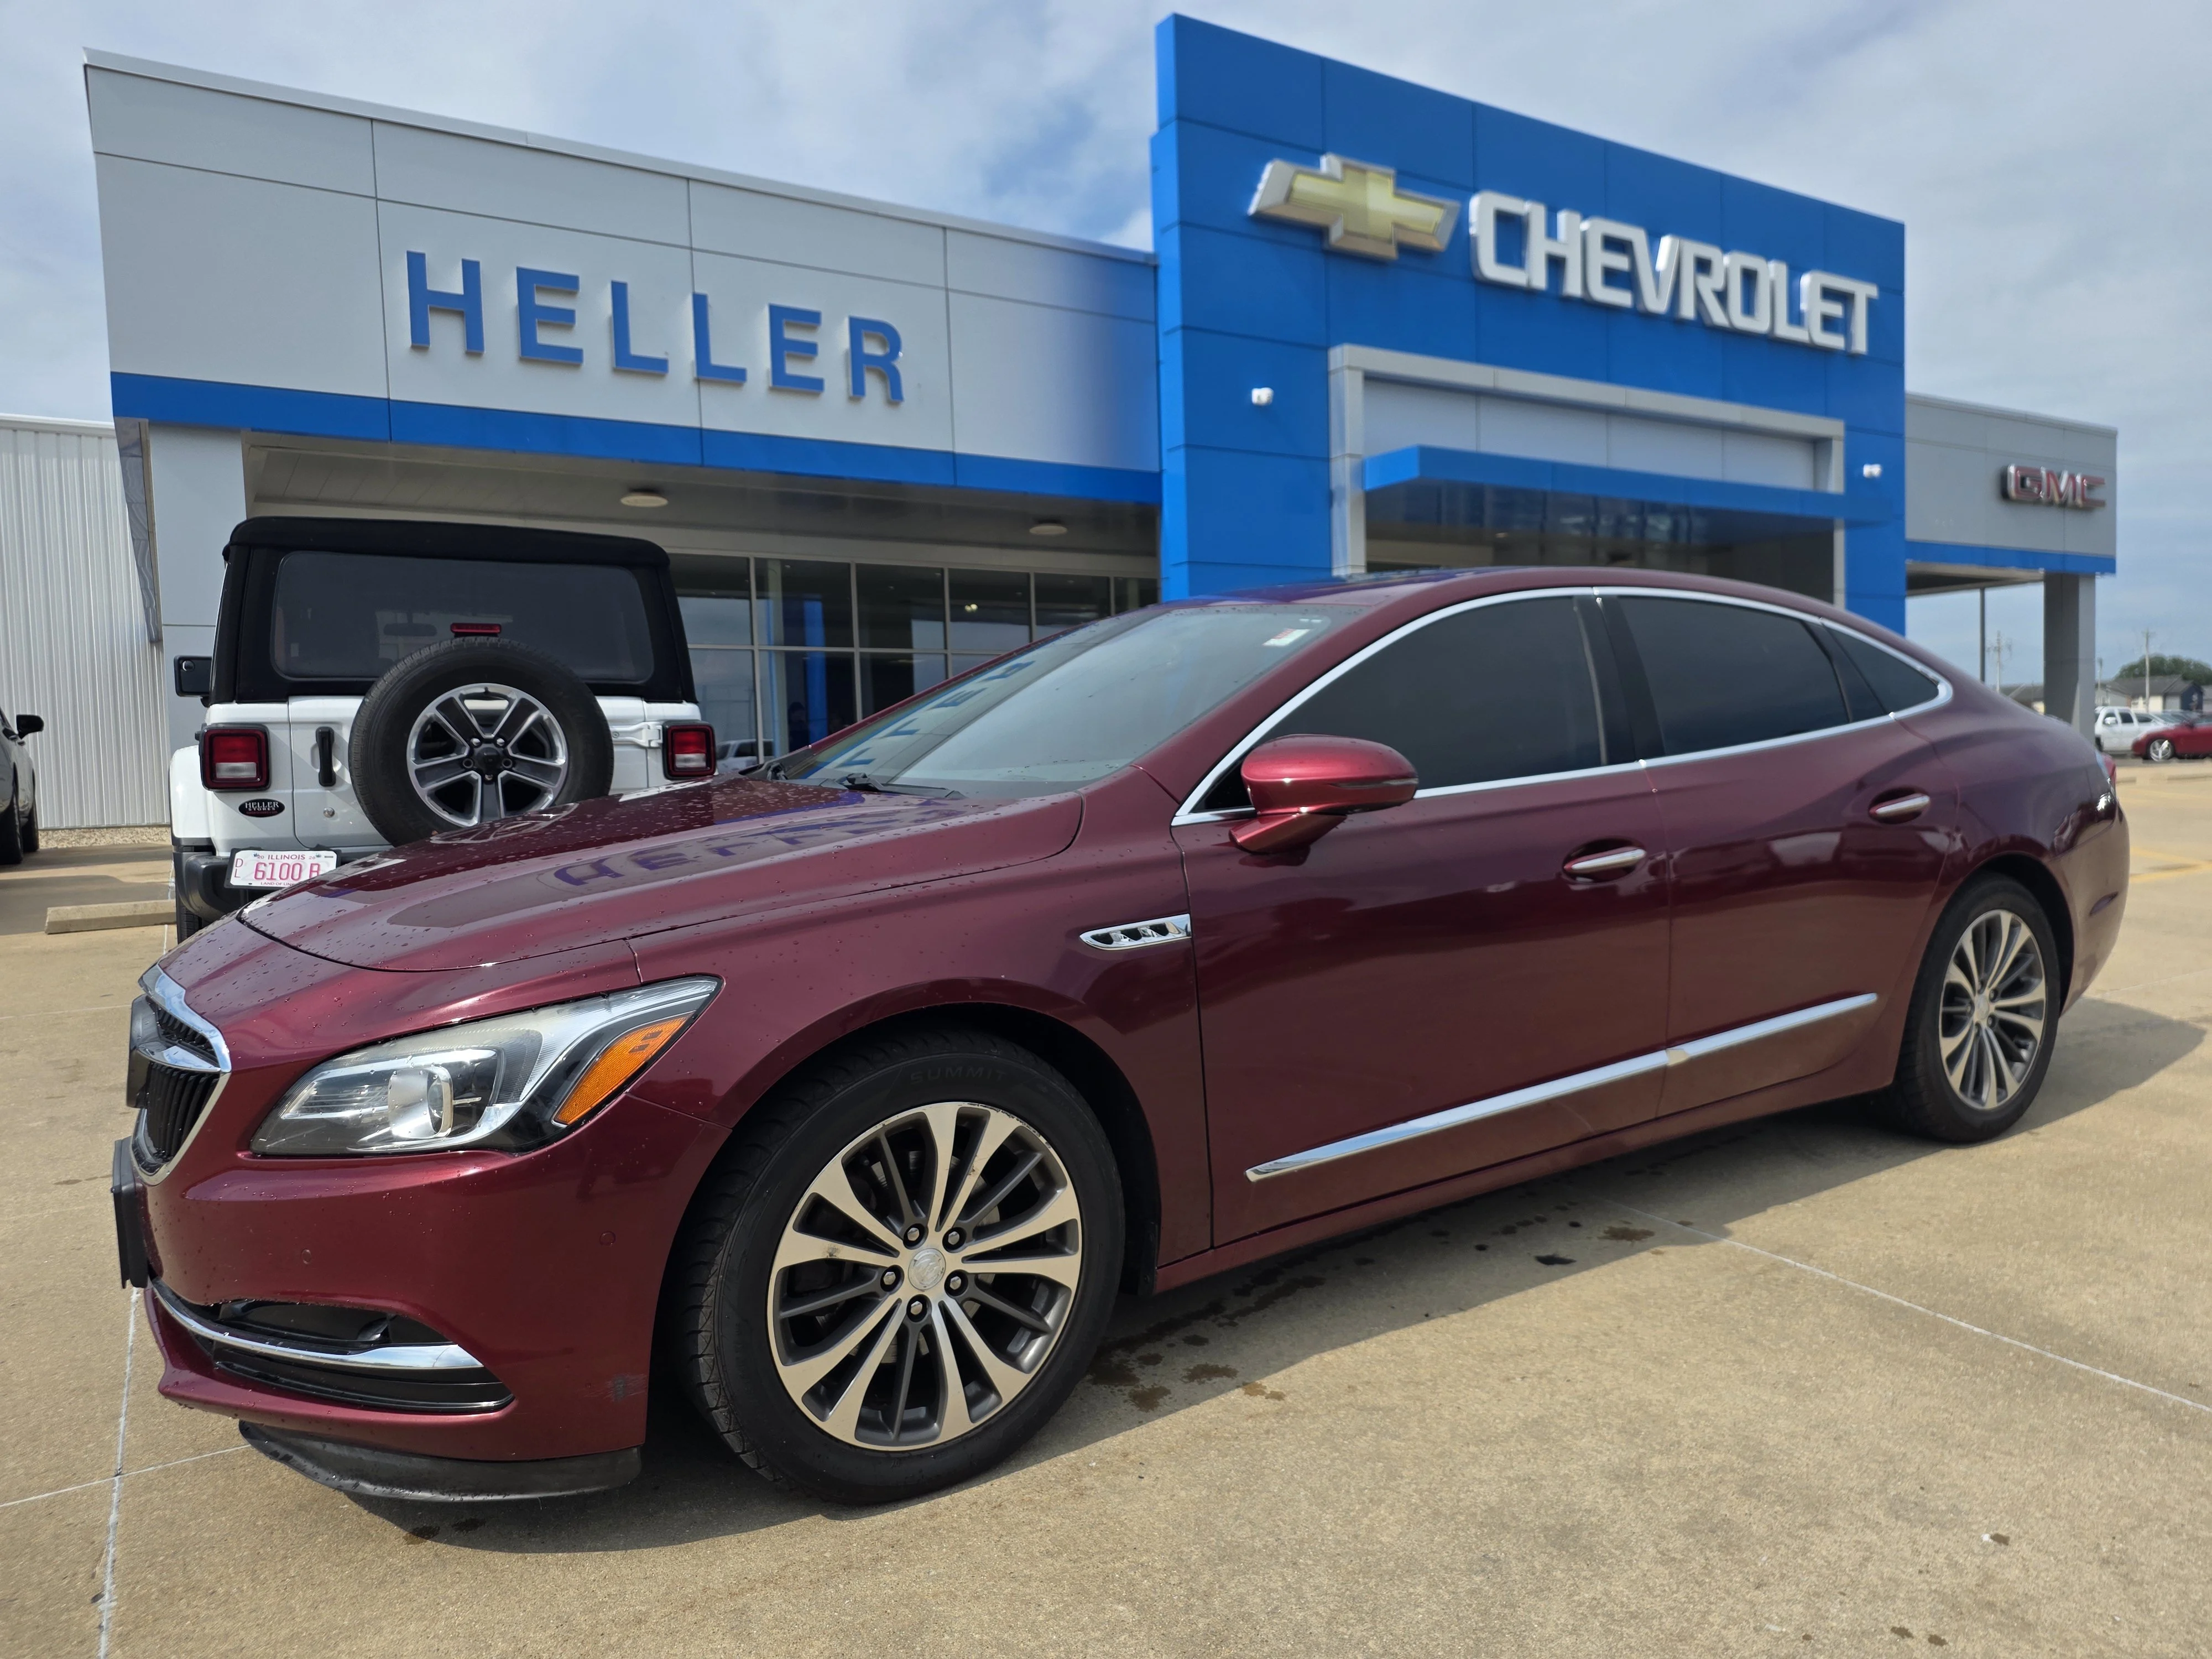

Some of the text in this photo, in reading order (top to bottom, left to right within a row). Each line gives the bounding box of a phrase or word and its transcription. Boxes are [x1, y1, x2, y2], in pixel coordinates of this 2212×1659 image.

[1469, 190, 1879, 356] CHEVROLET
[406, 250, 904, 404] HELLER
[2003, 464, 2106, 508] GMC
[254, 862, 302, 881] 6100
[910, 1066, 1007, 1085] SUMMIT
